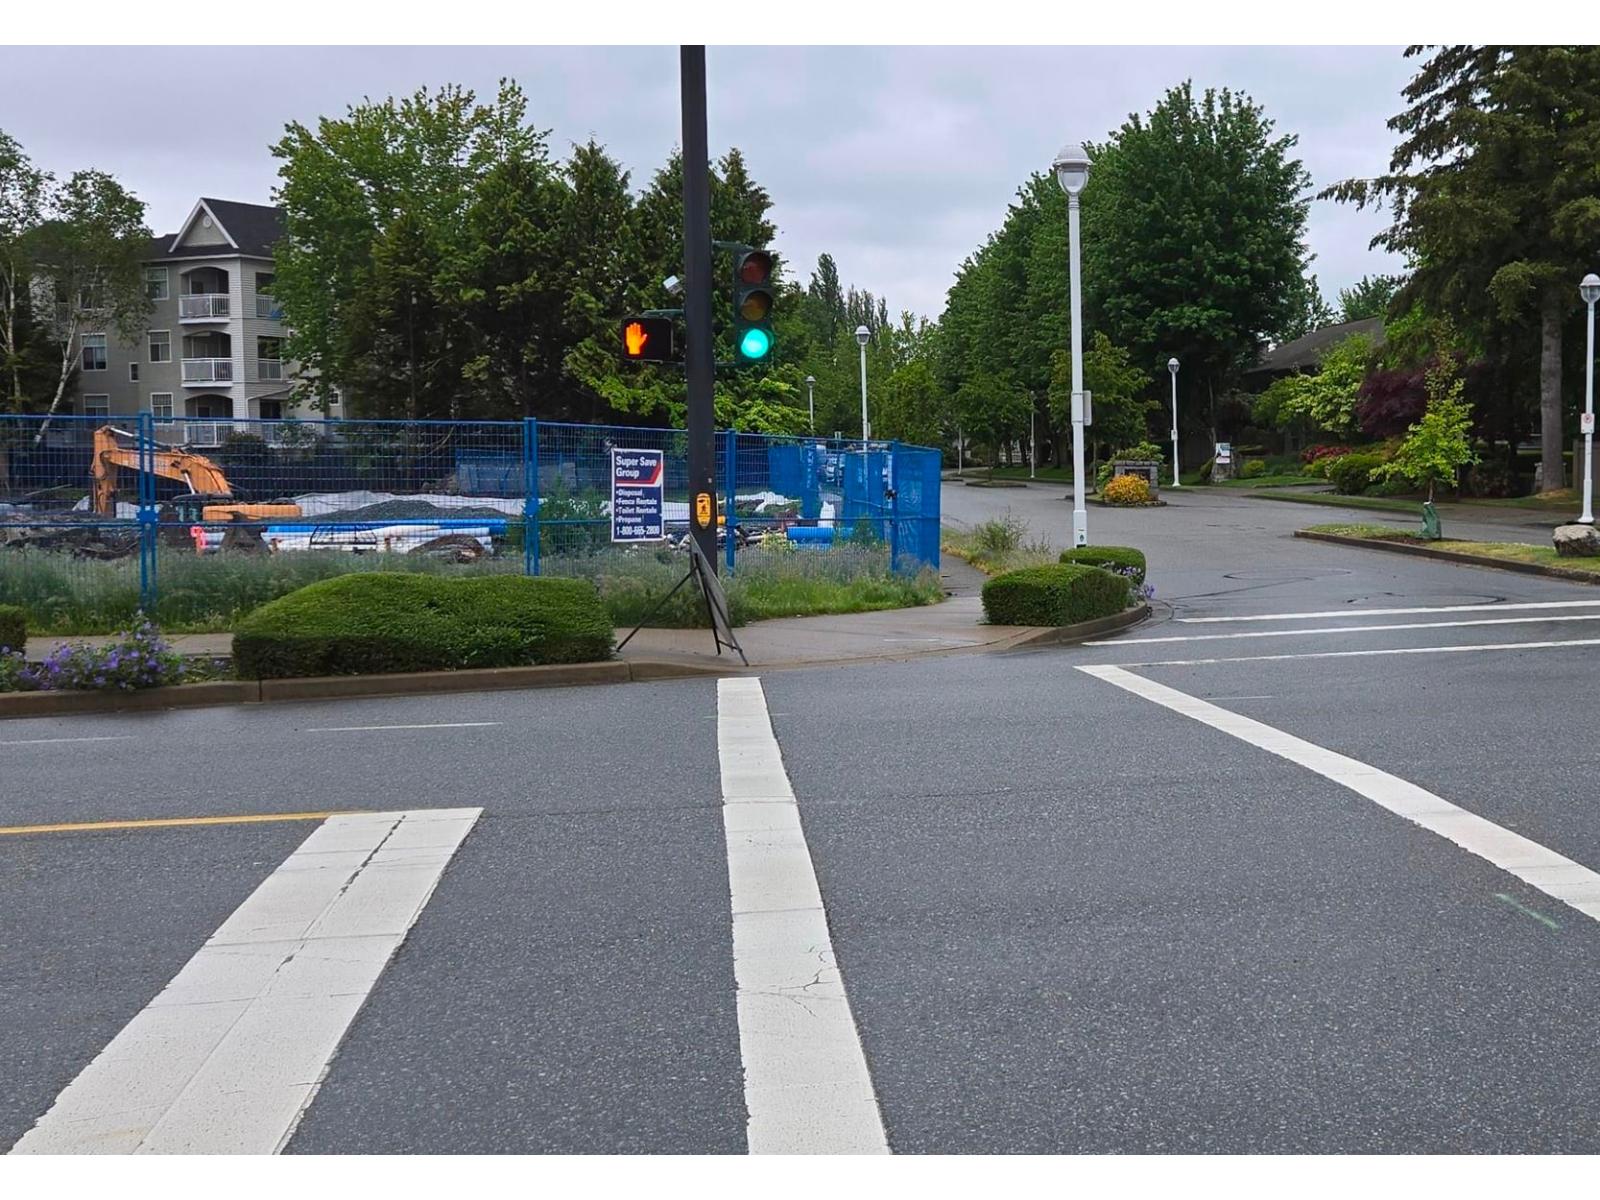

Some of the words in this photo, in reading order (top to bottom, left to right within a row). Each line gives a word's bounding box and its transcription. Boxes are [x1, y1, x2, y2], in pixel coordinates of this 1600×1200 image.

[616, 456, 639, 468] Super
[640, 456, 657, 467] Save
[616, 467, 639, 479] Group
